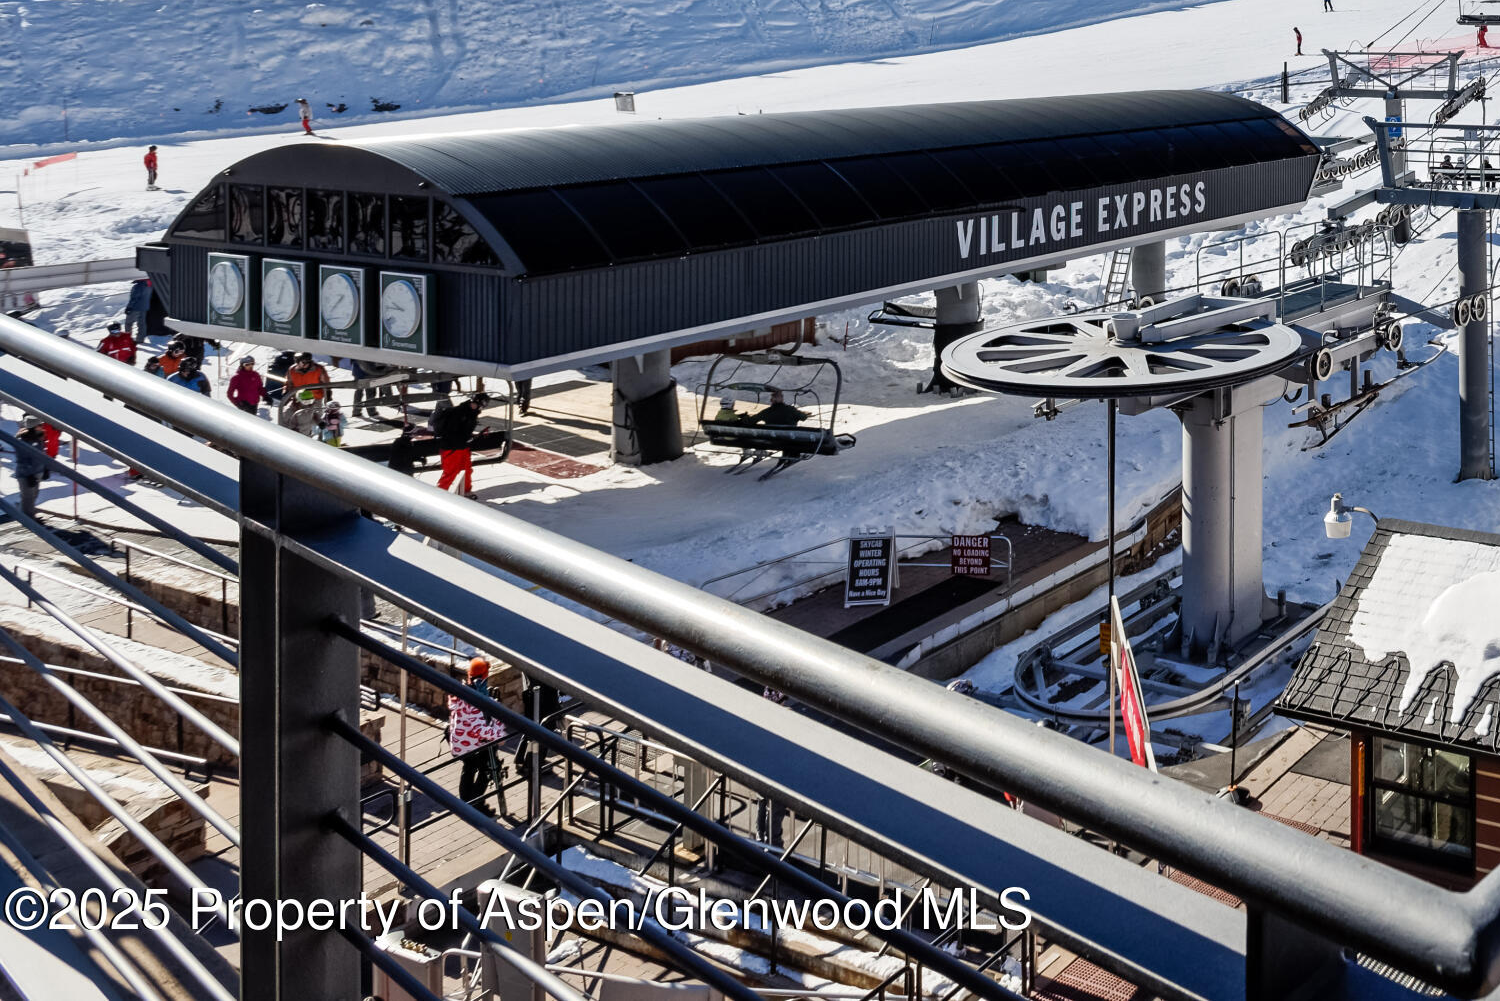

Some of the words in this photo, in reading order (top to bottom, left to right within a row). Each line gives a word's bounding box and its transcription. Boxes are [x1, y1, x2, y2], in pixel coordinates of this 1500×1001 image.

[956, 201, 1083, 259] VILLAGE
[1098, 181, 1206, 233] EXPRESS
[953, 536, 989, 548] DANGER
[963, 549, 989, 557] LOADING
[853, 559, 887, 567] OPERATING
[959, 557, 983, 566] BEYOND
[859, 568, 879, 577] HOURS
[954, 566, 968, 574] THIS
[970, 566, 988, 574] POINT
